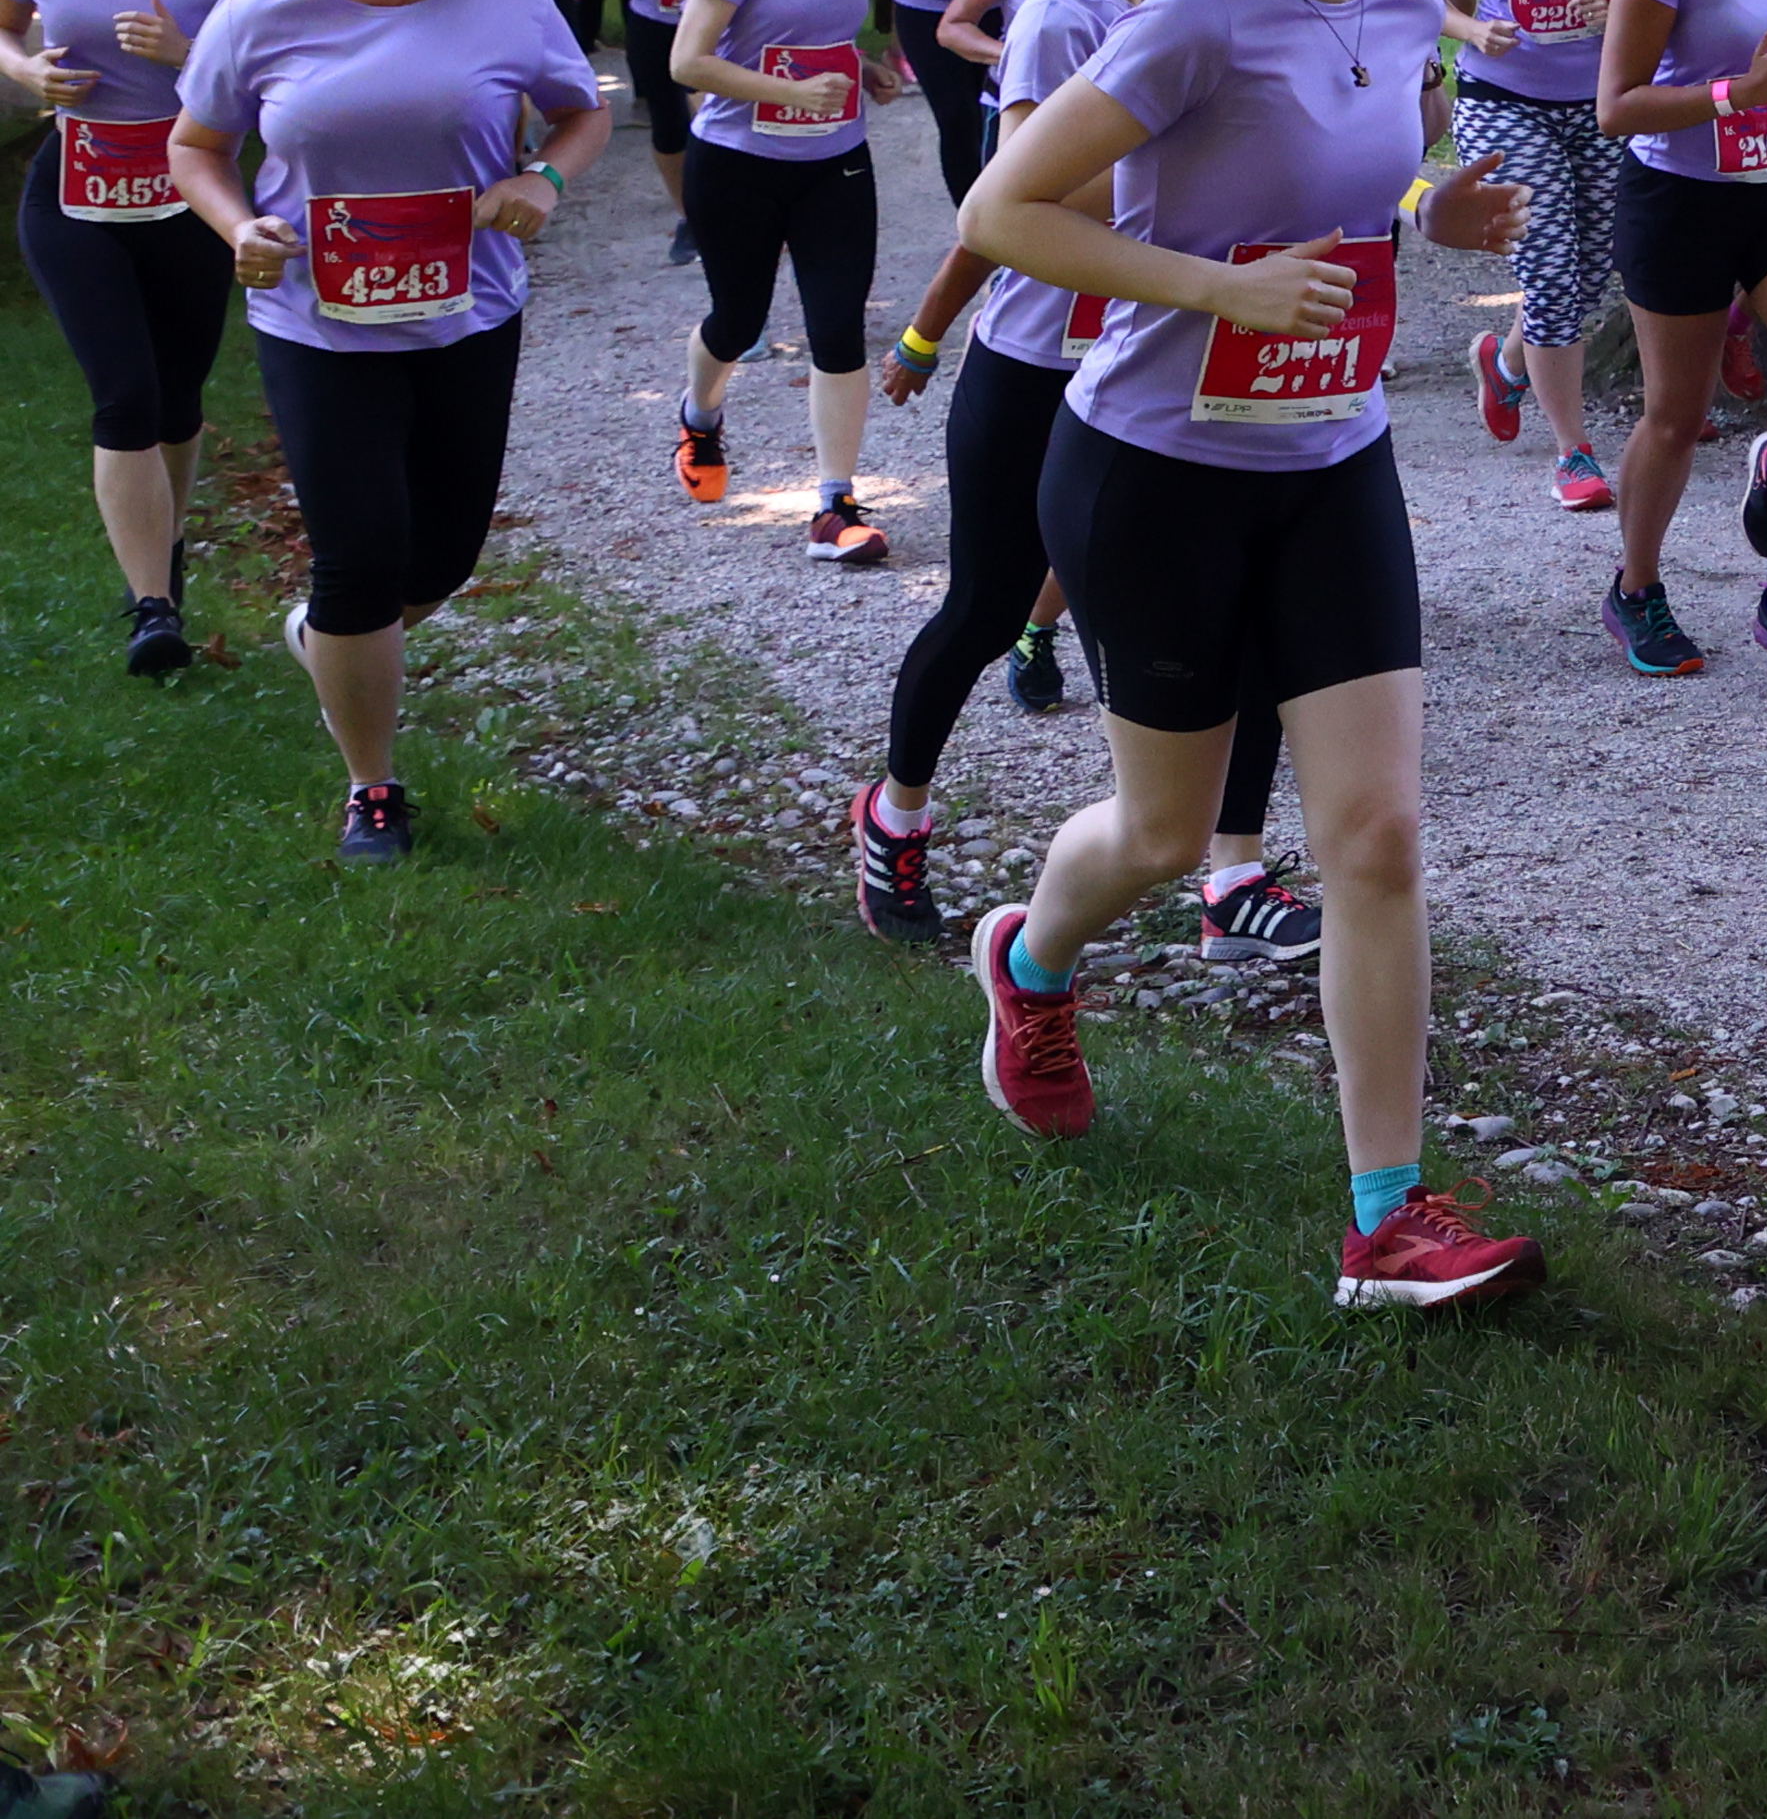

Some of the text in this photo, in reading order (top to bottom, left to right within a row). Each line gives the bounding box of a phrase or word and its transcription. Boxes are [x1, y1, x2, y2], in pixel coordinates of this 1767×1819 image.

[1531, 5, 1583, 30] 228
[85, 174, 173, 206] 0459
[341, 260, 450, 304] 4243
[1249, 334, 1361, 393] 2771
